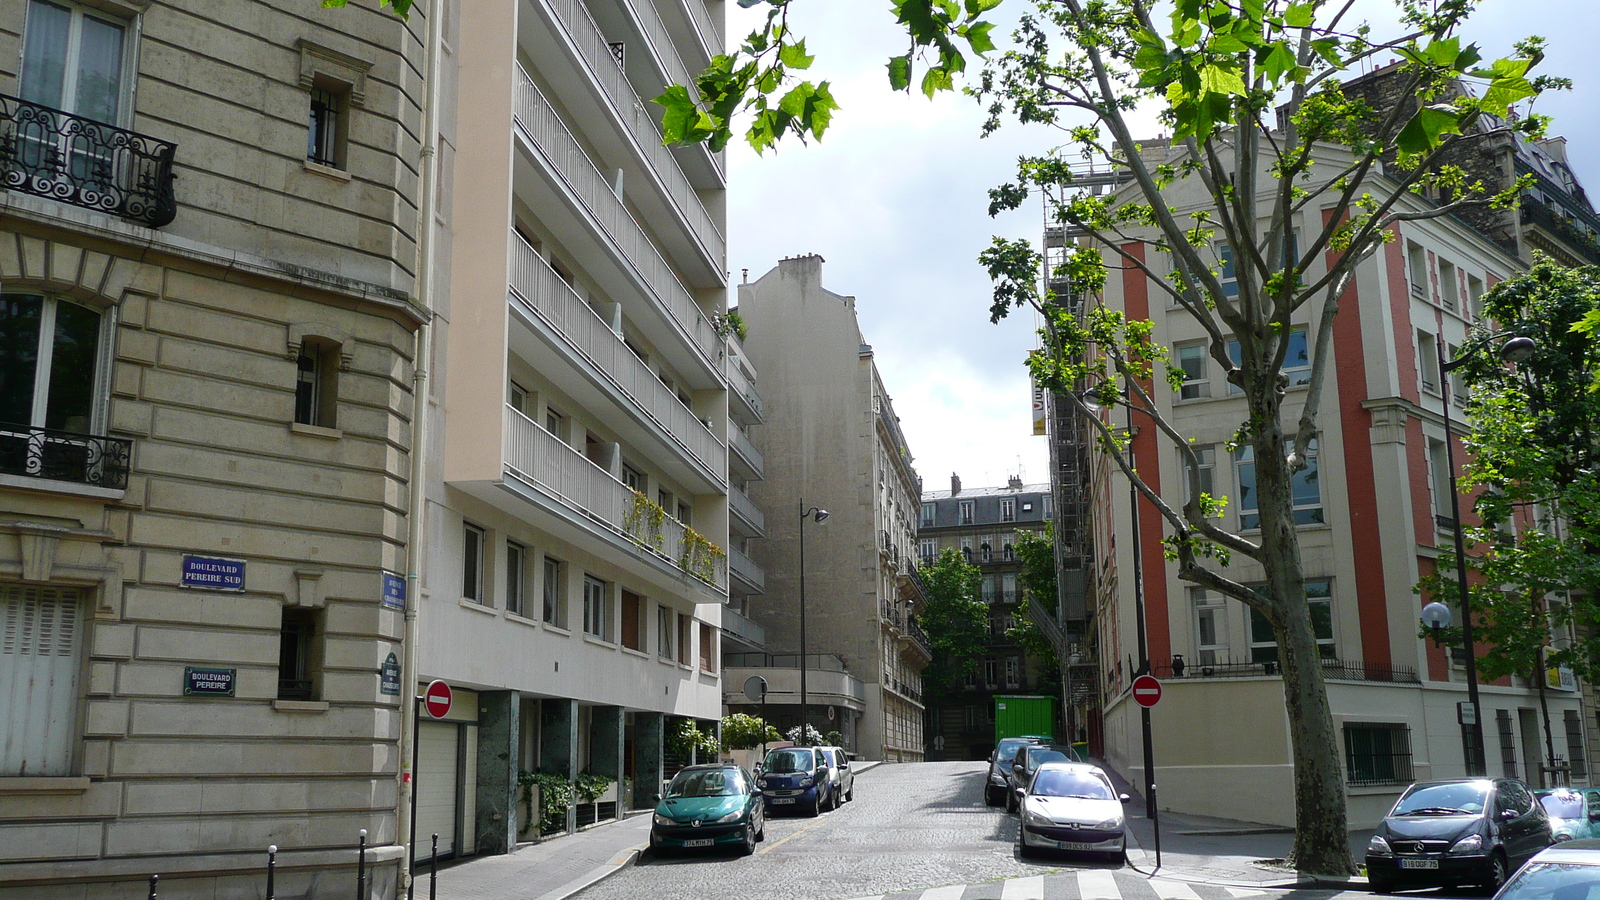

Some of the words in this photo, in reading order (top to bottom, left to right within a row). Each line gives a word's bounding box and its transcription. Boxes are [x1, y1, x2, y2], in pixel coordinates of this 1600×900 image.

[190, 562, 237, 574] BOULEVARD
[185, 572, 222, 582] PEREIRE
[224, 576, 241, 585] SUD
[192, 673, 231, 682] BOULEVARD
[196, 681, 227, 690] PEREIRE
[1428, 860, 1438, 868] 75
